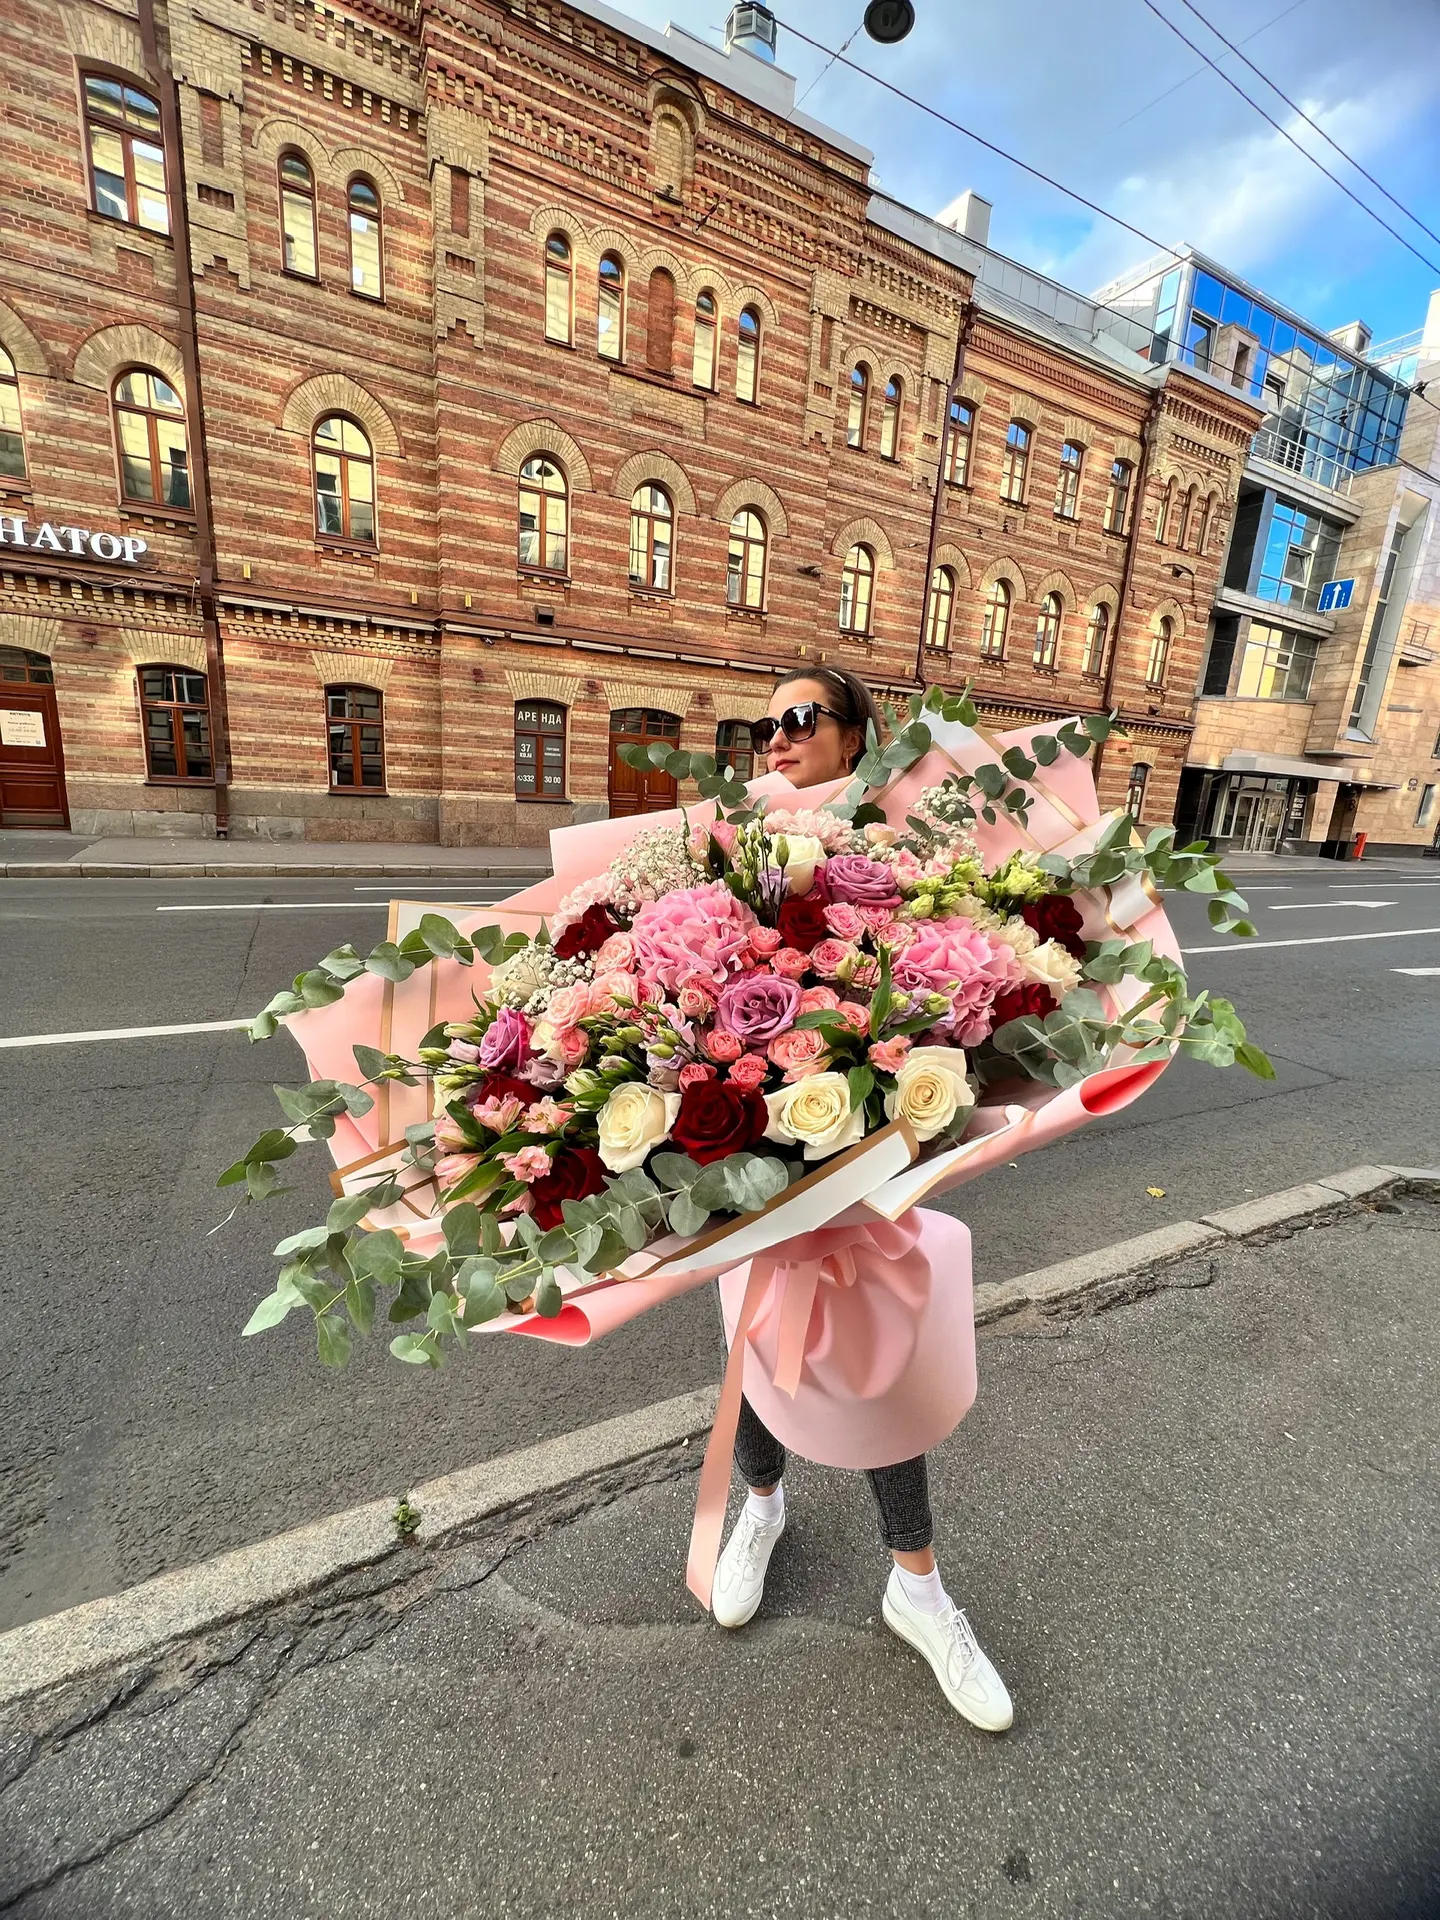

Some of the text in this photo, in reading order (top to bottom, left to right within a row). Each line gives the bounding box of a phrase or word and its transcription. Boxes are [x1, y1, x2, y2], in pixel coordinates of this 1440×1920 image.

[0, 516, 147, 562] НАТОР
[520, 743, 531, 753] 37
[523, 774, 561, 784] 332 30 00
